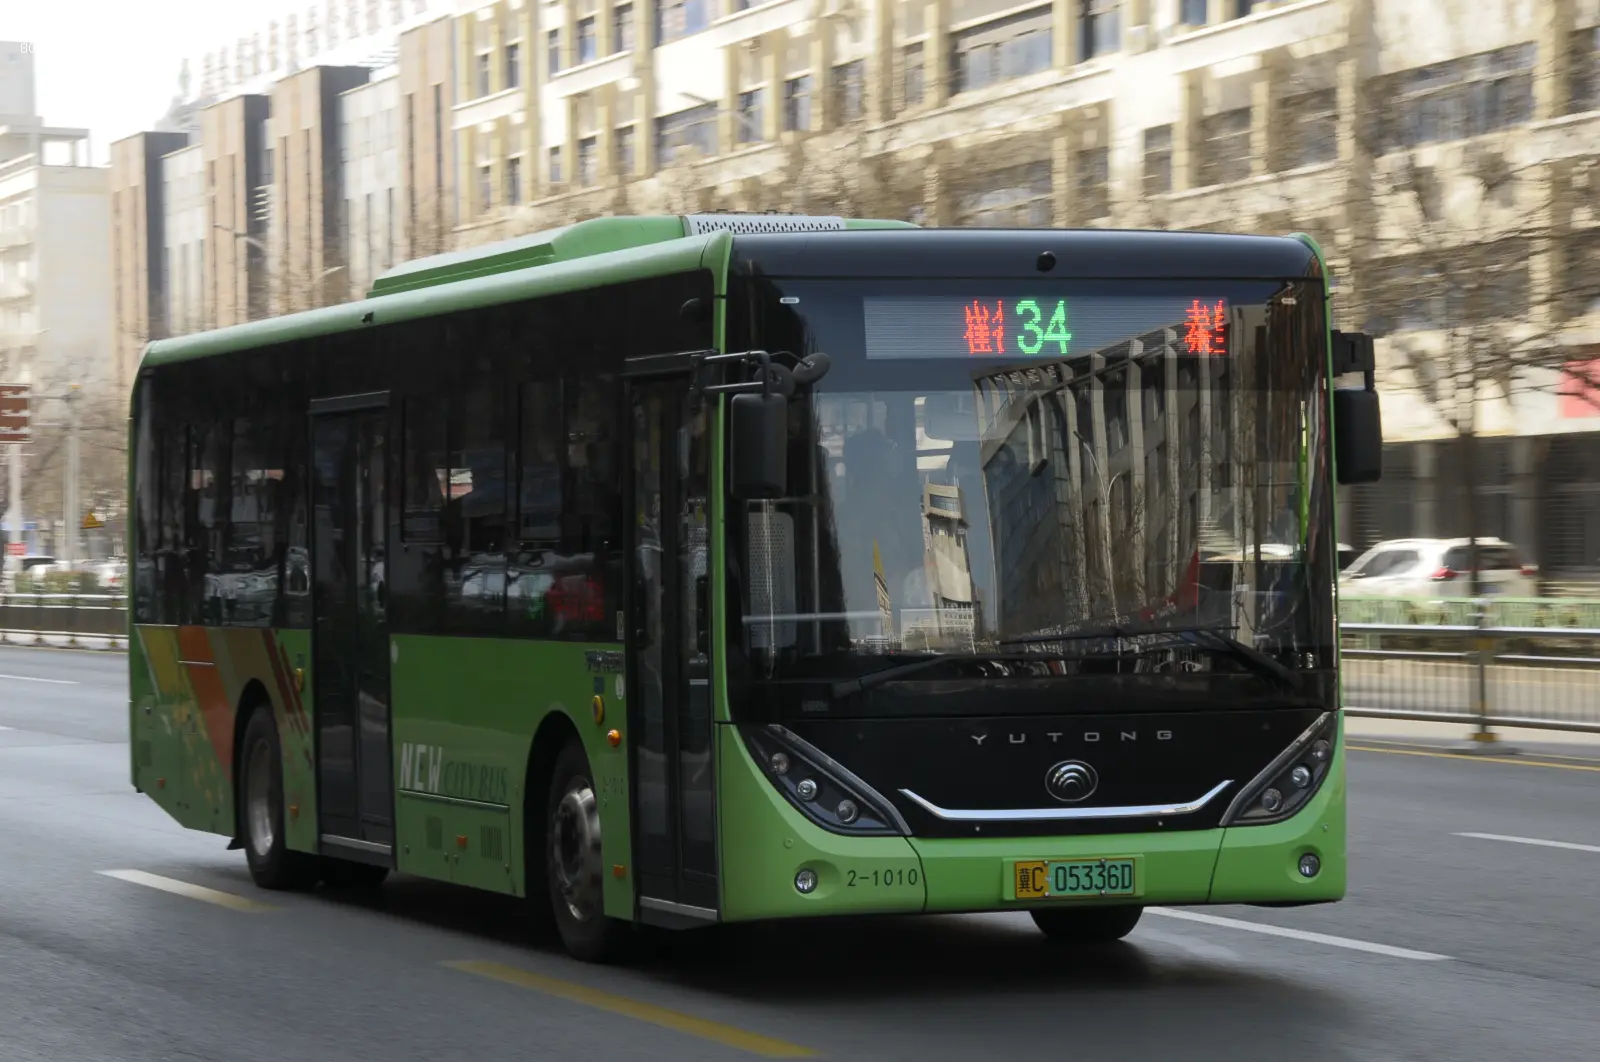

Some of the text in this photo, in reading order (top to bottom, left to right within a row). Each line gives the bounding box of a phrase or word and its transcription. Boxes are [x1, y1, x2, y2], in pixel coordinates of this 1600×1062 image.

[1016, 300, 1072, 354] 34
[971, 729, 1173, 745] YUTONG
[400, 742, 508, 802] NEW CITY BUS
[847, 868, 918, 887] 2-1010
[1018, 863, 1132, 892] 冀C 05336D
